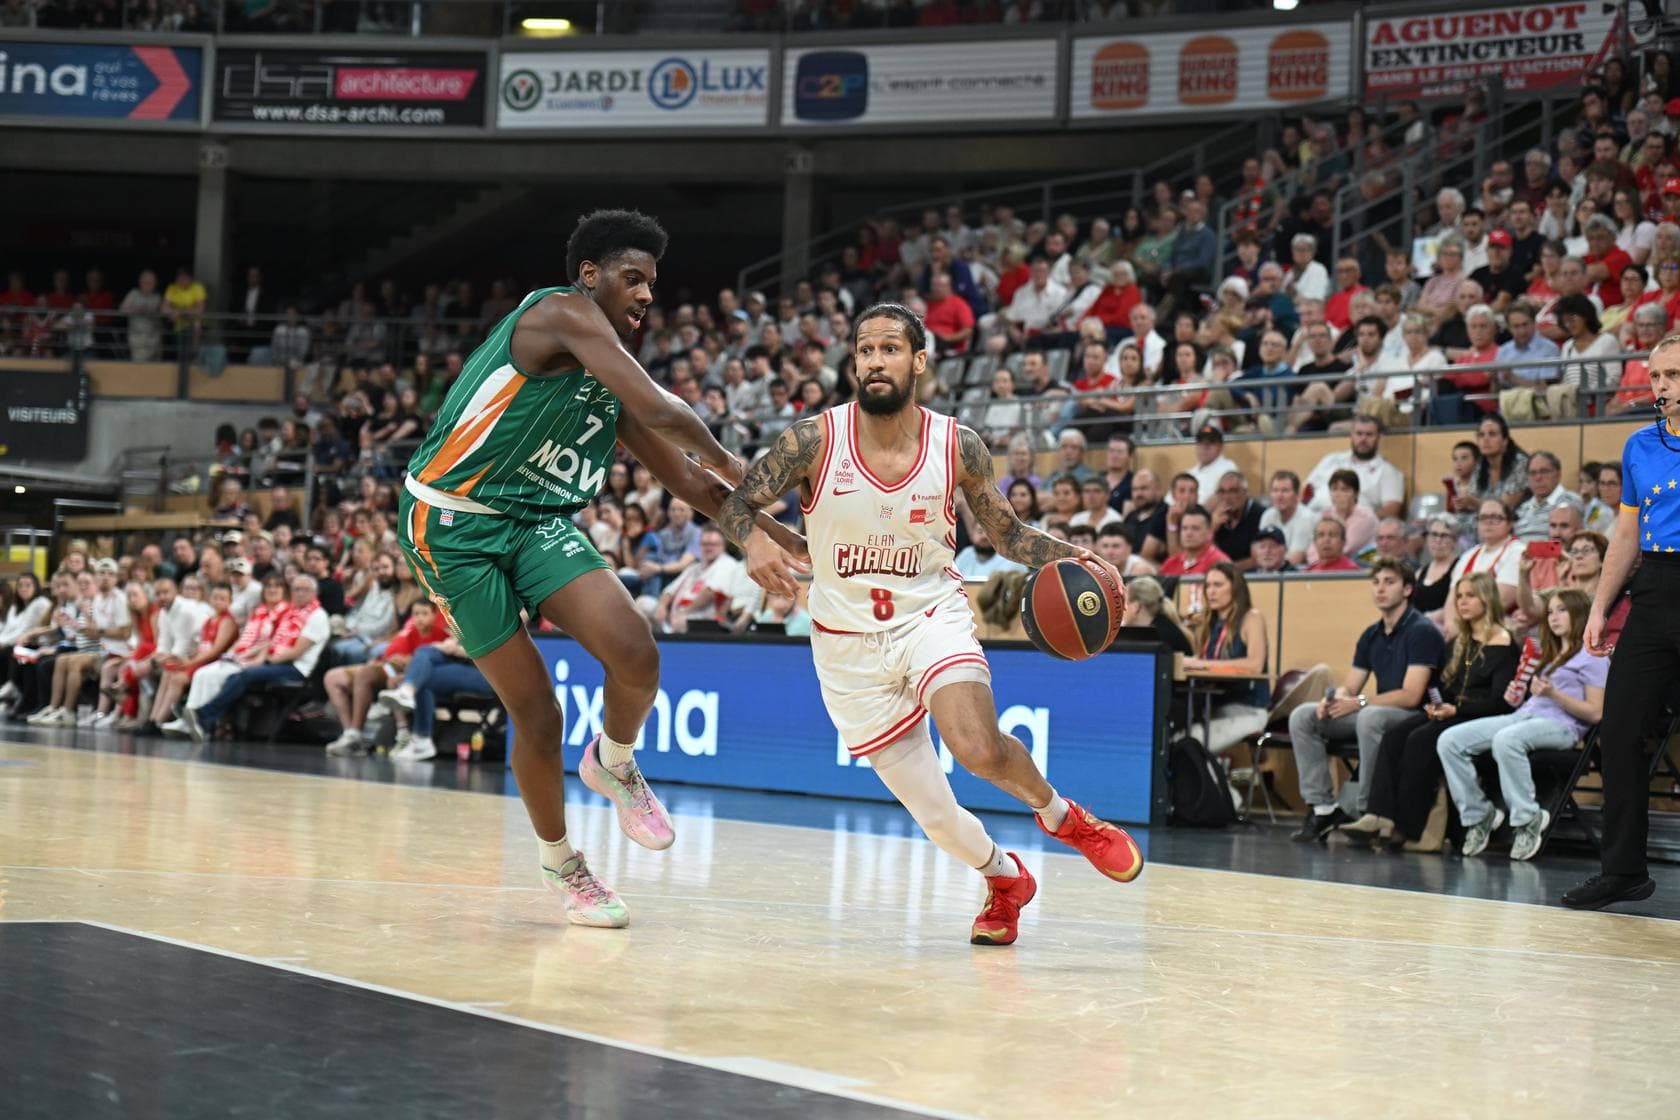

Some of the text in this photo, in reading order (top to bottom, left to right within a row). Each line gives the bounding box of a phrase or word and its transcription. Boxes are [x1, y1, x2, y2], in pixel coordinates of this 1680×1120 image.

[1372, 4, 1586, 45] AGUENOT
[1372, 33, 1585, 68] EXTINCTEUR
[340, 71, 464, 96] architecture
[548, 70, 643, 93] JARDI
[1092, 77, 1149, 98] KING
[1179, 71, 1237, 92] KING
[1269, 65, 1327, 88] KING
[252, 104, 445, 123] www.dsa-archi.com
[7, 406, 79, 424] VISITEURS
[575, 414, 604, 446] 7
[833, 542, 924, 578] CHALON
[870, 588, 895, 621] 8
[555, 658, 720, 757] ixna
